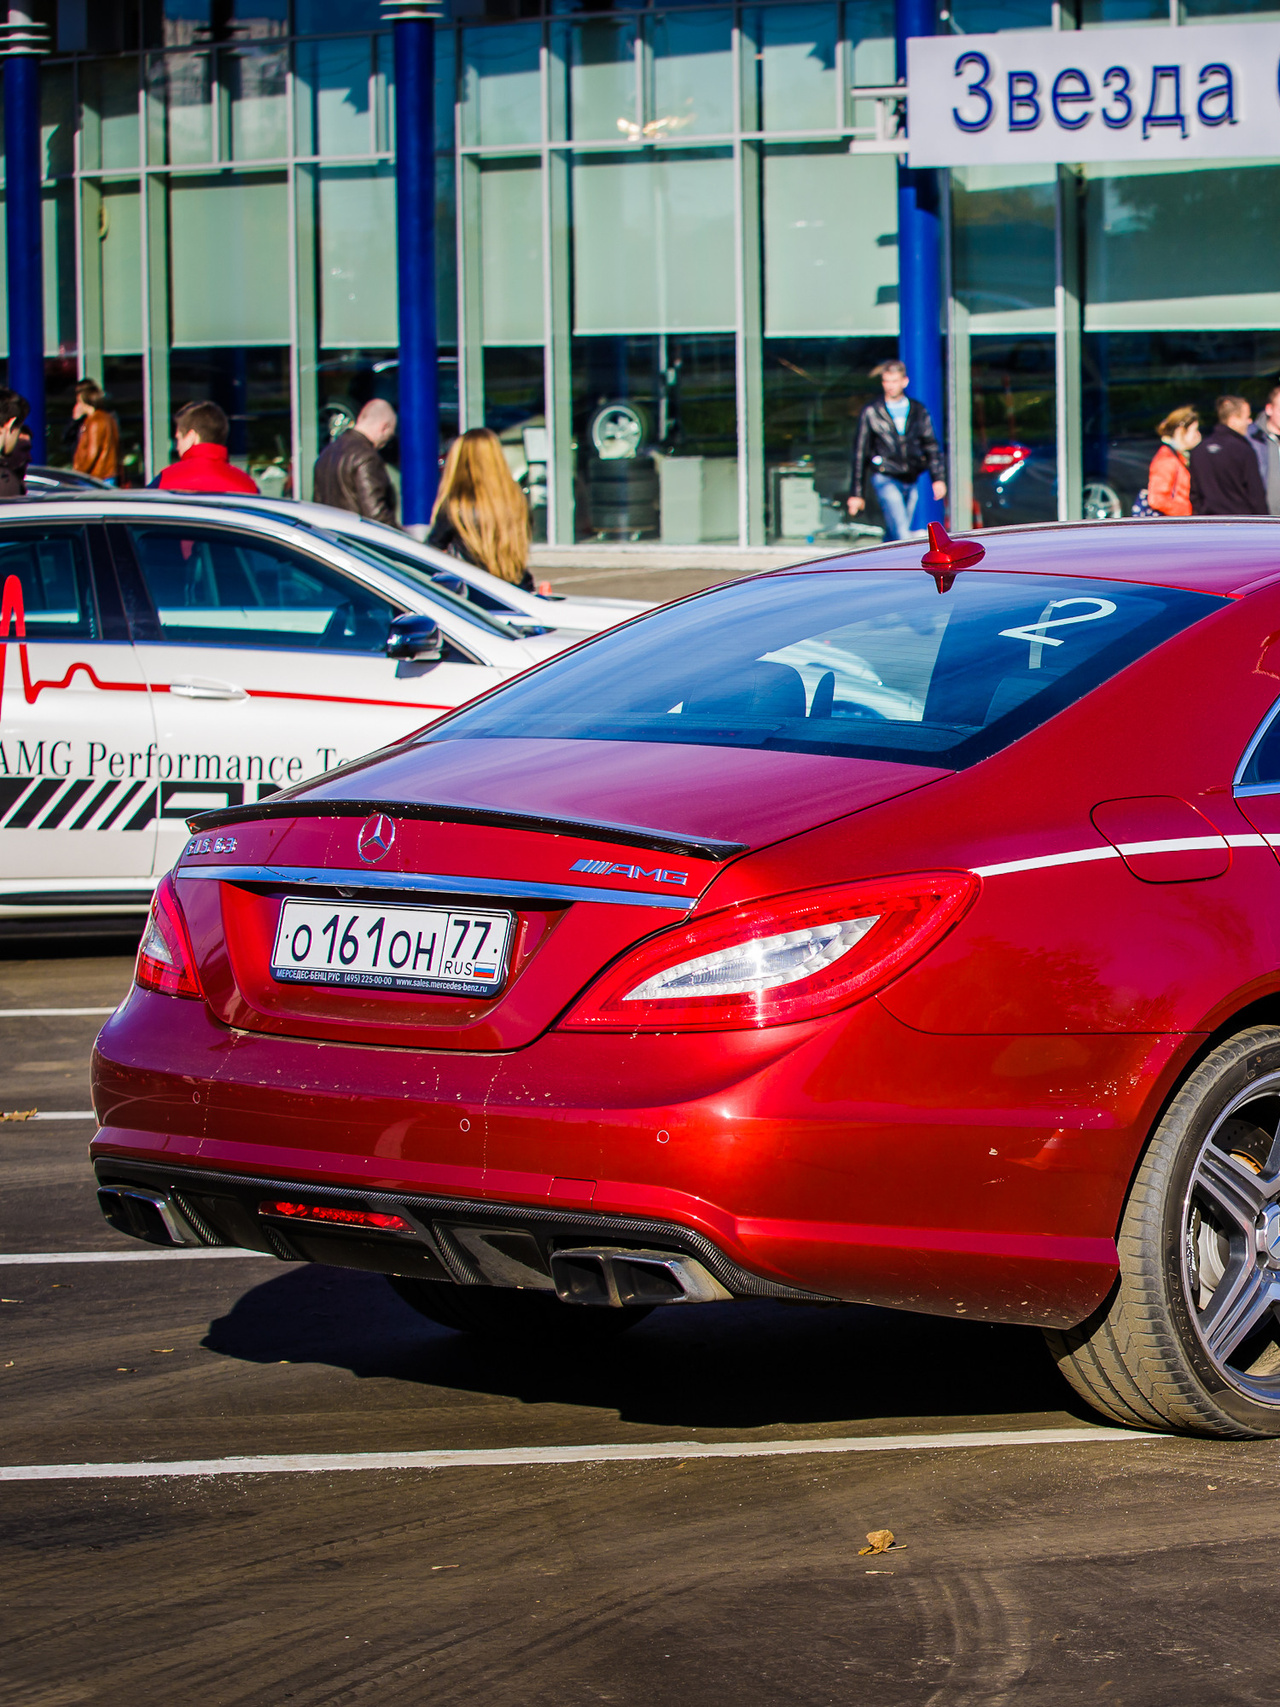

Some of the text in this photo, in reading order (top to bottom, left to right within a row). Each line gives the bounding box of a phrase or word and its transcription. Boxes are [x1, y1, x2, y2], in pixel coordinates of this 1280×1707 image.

[951, 50, 1239, 138] Звезда
[87, 742, 303, 782] Performance
[213, 837, 237, 854] 63
[605, 863, 688, 886] AMG
[451, 919, 492, 960] 77
[276, 968, 488, 993] МЕРСЕДЕС-БЕНЦ РУС (495) 225-00-00 www.sales.mercedes-benz.ru
[444, 960, 473, 976] RUS
